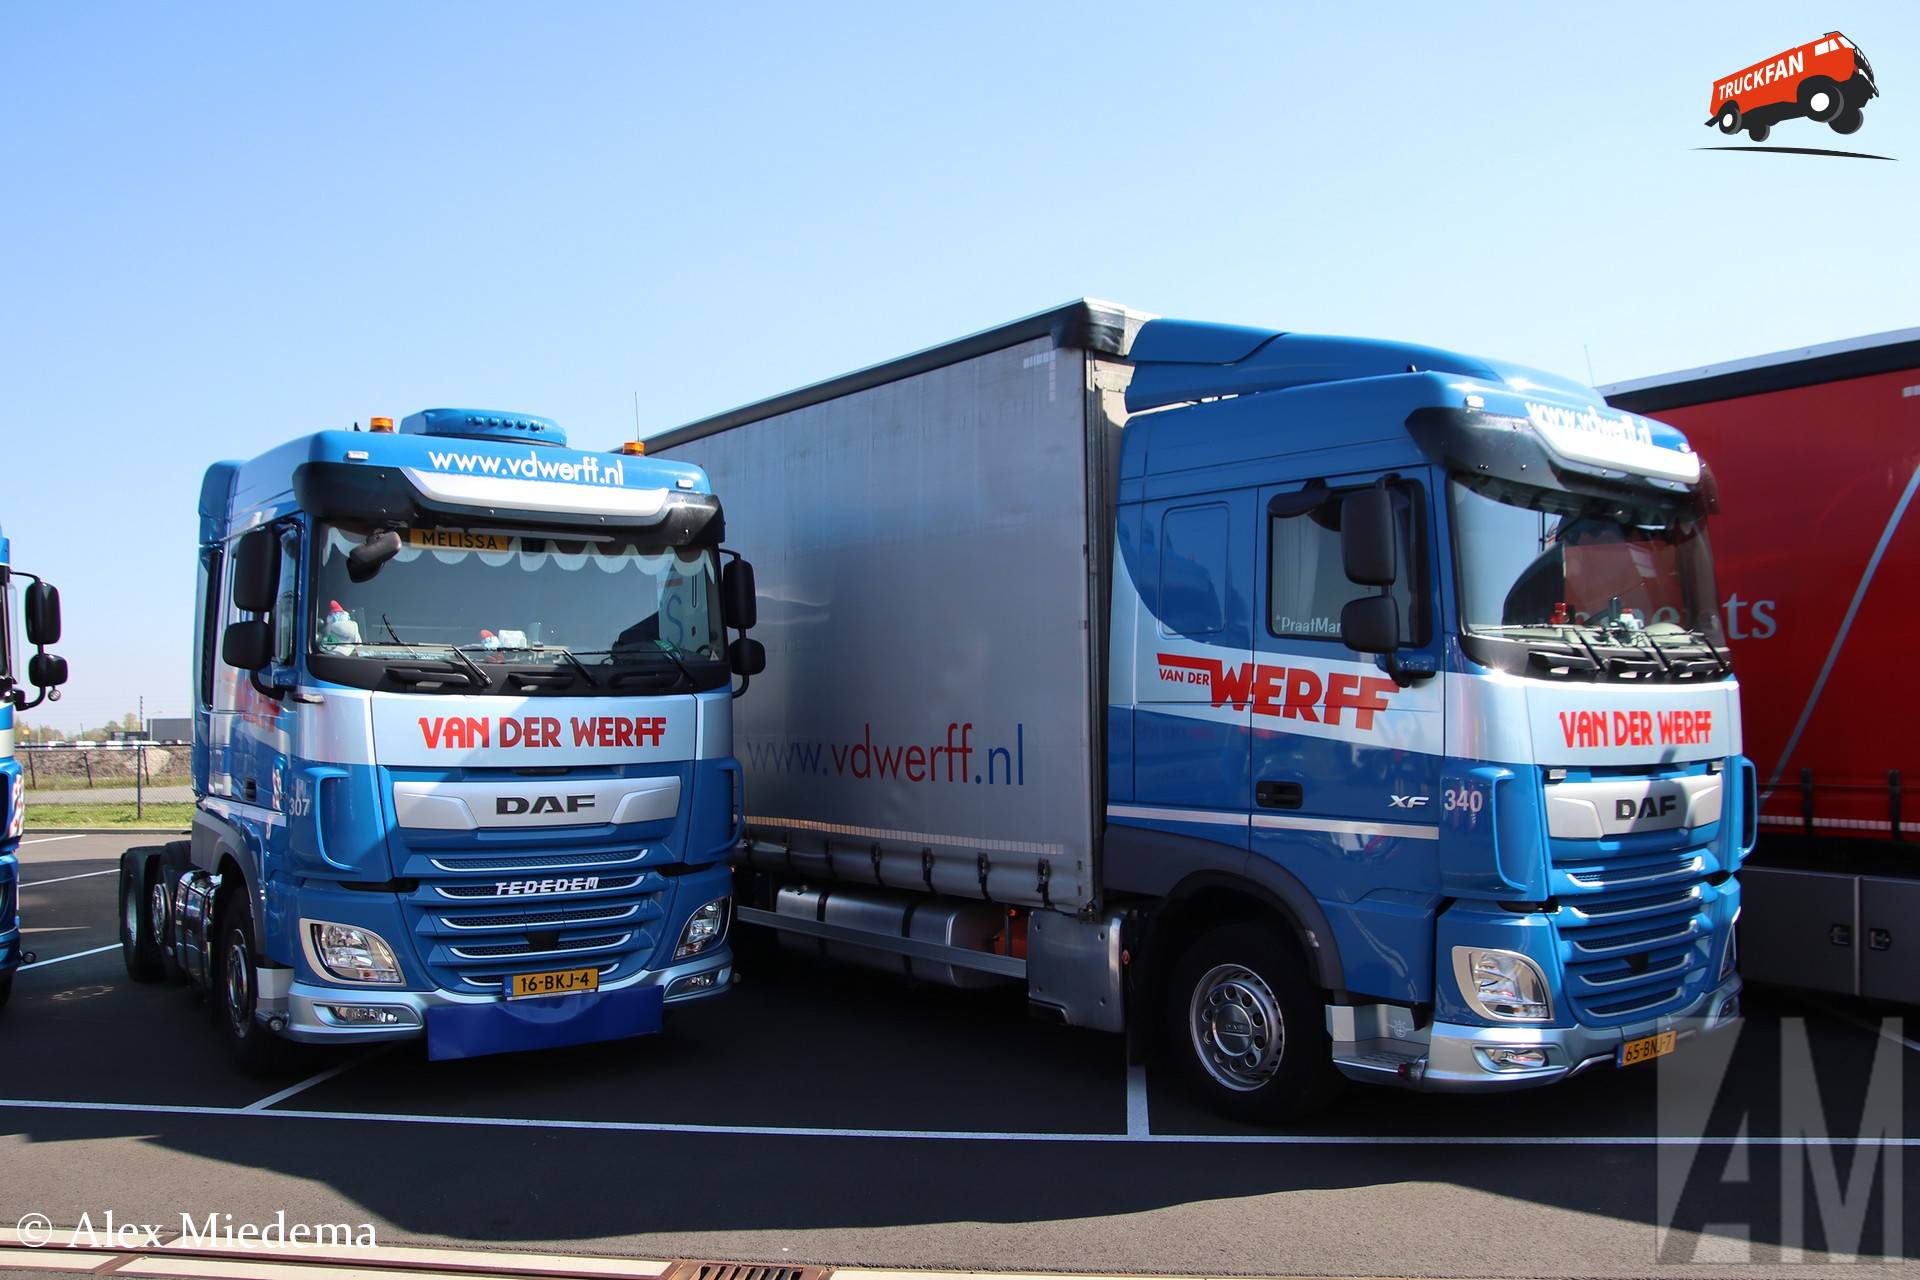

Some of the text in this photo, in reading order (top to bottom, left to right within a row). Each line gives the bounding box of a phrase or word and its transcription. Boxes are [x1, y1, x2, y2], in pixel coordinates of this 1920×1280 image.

[428, 450, 624, 485] www.vdwerff.nl
[422, 531, 498, 549] MELISSA
[1157, 653, 1400, 730] VAN DER WERFF
[418, 717, 666, 748] VAN DER WERFF
[1559, 711, 1712, 748] VAN DER WERFF
[747, 723, 1024, 786] www.vdwerff.nl
[289, 798, 310, 816] 307
[496, 794, 595, 815] DAF
[1388, 795, 1429, 808] XF
[1444, 788, 1483, 812] 340
[1616, 795, 1676, 820] DAF
[495, 877, 599, 896] TEDEDEM
[521, 972, 590, 992] 16-BKJ-4
[1626, 1034, 1672, 1060] 65-BNJ-7
